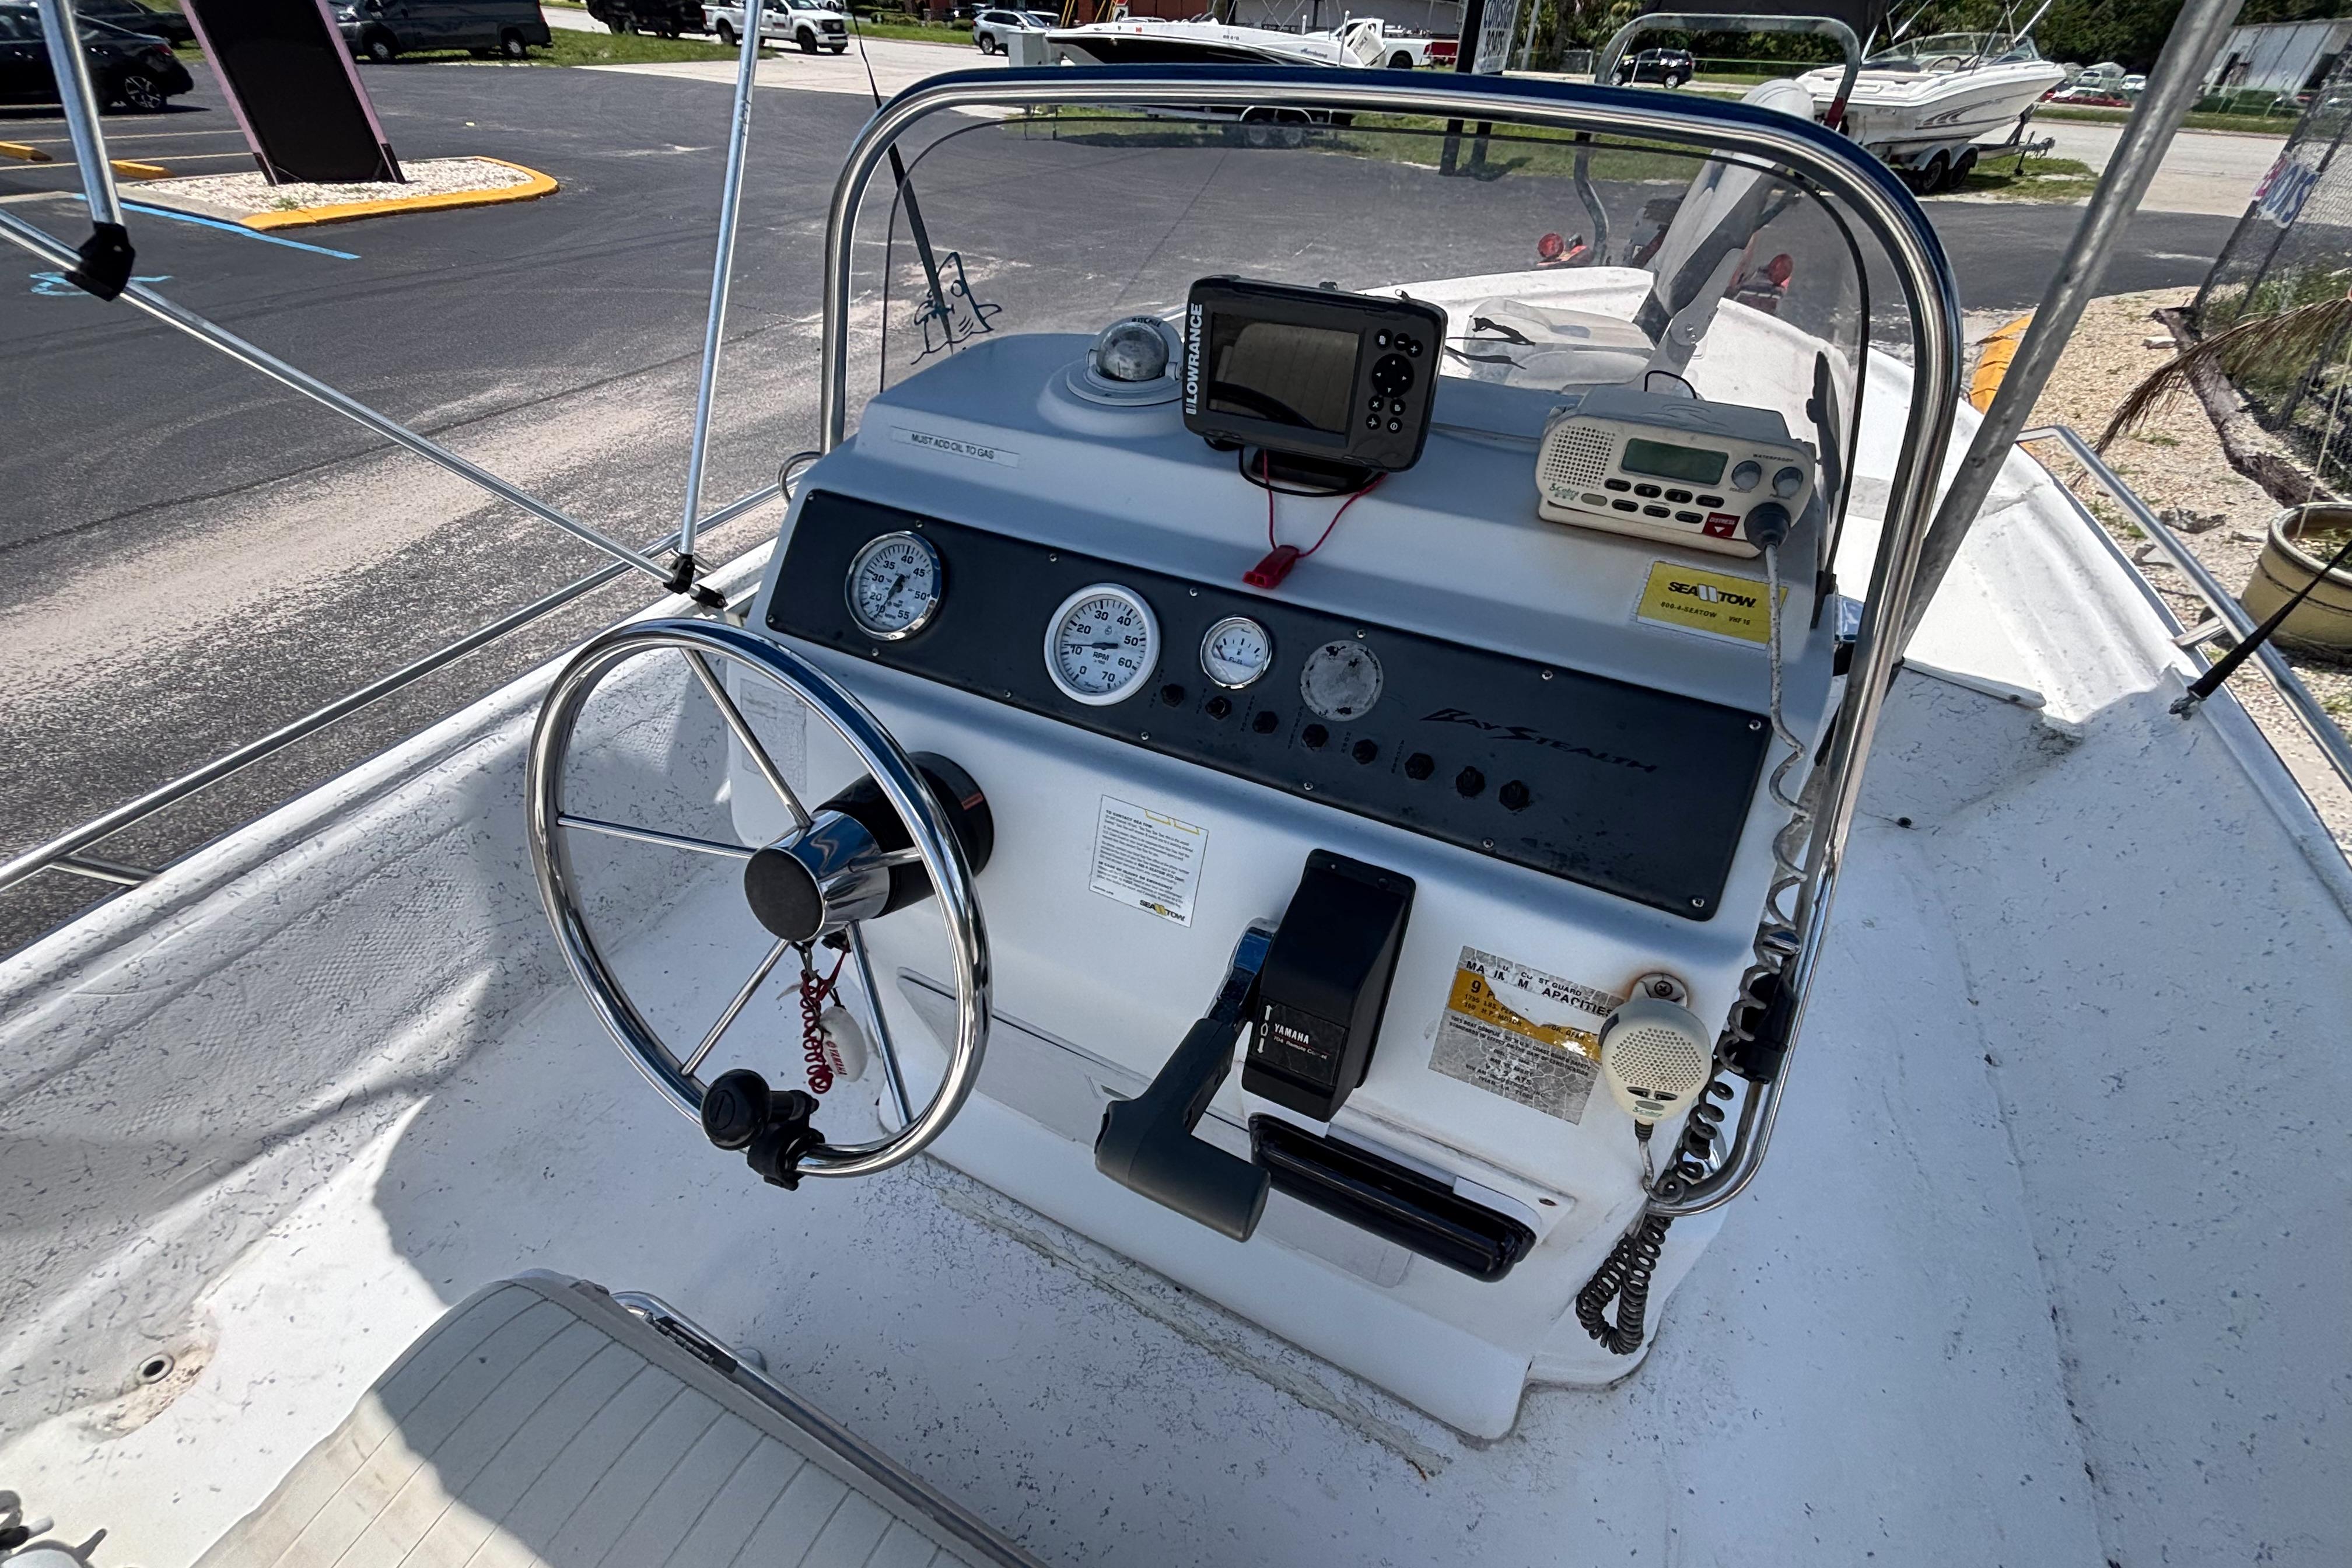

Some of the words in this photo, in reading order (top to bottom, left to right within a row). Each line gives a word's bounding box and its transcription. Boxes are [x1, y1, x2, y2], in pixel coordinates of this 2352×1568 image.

[1186, 303, 1202, 404] LOWRANCE
[912, 433, 933, 444] MUST
[934, 439, 950, 449] ADD
[950, 442, 964, 452] OIL
[965, 445, 977, 454] TO
[977, 448, 995, 459] GAS
[1753, 453, 1794, 463] WATERPROOF
[1709, 517, 1736, 525] DISTRESS
[883, 560, 896, 570] 35
[901, 555, 914, 565] 40
[872, 573, 884, 583] 30
[914, 568, 926, 578] 45
[870, 592, 882, 601] 20
[915, 592, 928, 600] 50
[1668, 582, 1698, 597] SEA
[1717, 591, 1756, 608] TOW
[875, 604, 886, 613] 10
[1661, 601, 1718, 618] 800-4-SEATOW
[1729, 615, 1742, 624] VHF
[897, 610, 910, 620] 55
[1094, 610, 1109, 621] 30
[1116, 615, 1132, 626] 40
[1076, 624, 1091, 635] 20
[1124, 636, 1139, 646] 50
[1070, 646, 1083, 655] 10
[1093, 651, 1110, 662] RPM
[1118, 657, 1133, 668] 60
[1079, 665, 1087, 674] 0
[1101, 671, 1115, 682] 70
[1340, 732, 1351, 753] HORN
[1139, 900, 1156, 911] SEA
[1165, 910, 1185, 921] TOW
[1471, 980, 1480, 993] 9
[1552, 982, 1582, 996] GUARD
[1541, 988, 1613, 1017] APACITIES
[1275, 1023, 1309, 1045] YAMAHA
[1286, 1041, 1306, 1052] Remote
[829, 1049, 848, 1075] YAMAHA
